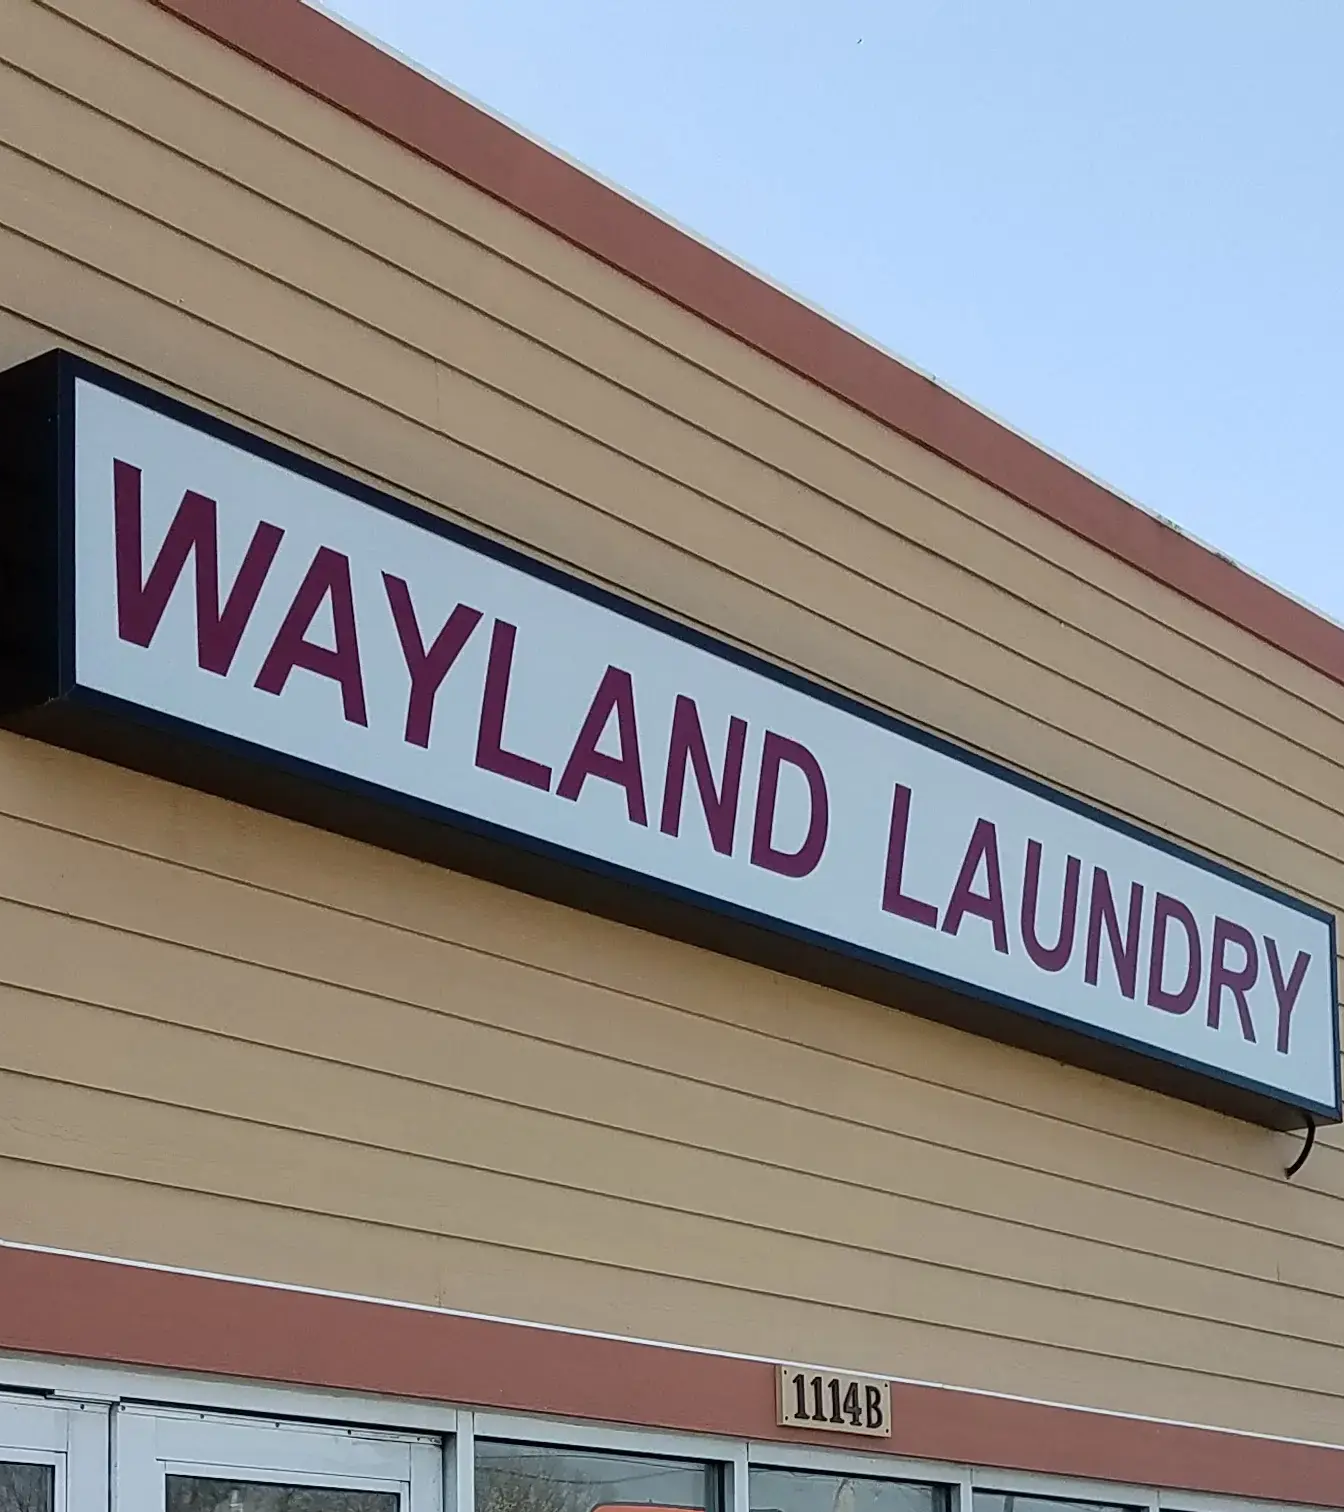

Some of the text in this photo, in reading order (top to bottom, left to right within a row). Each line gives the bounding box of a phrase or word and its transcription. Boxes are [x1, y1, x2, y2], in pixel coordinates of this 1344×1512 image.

[112, 458, 1312, 1055] WAYLAND LAUNDRY
[792, 1373, 883, 1429] 1114B
